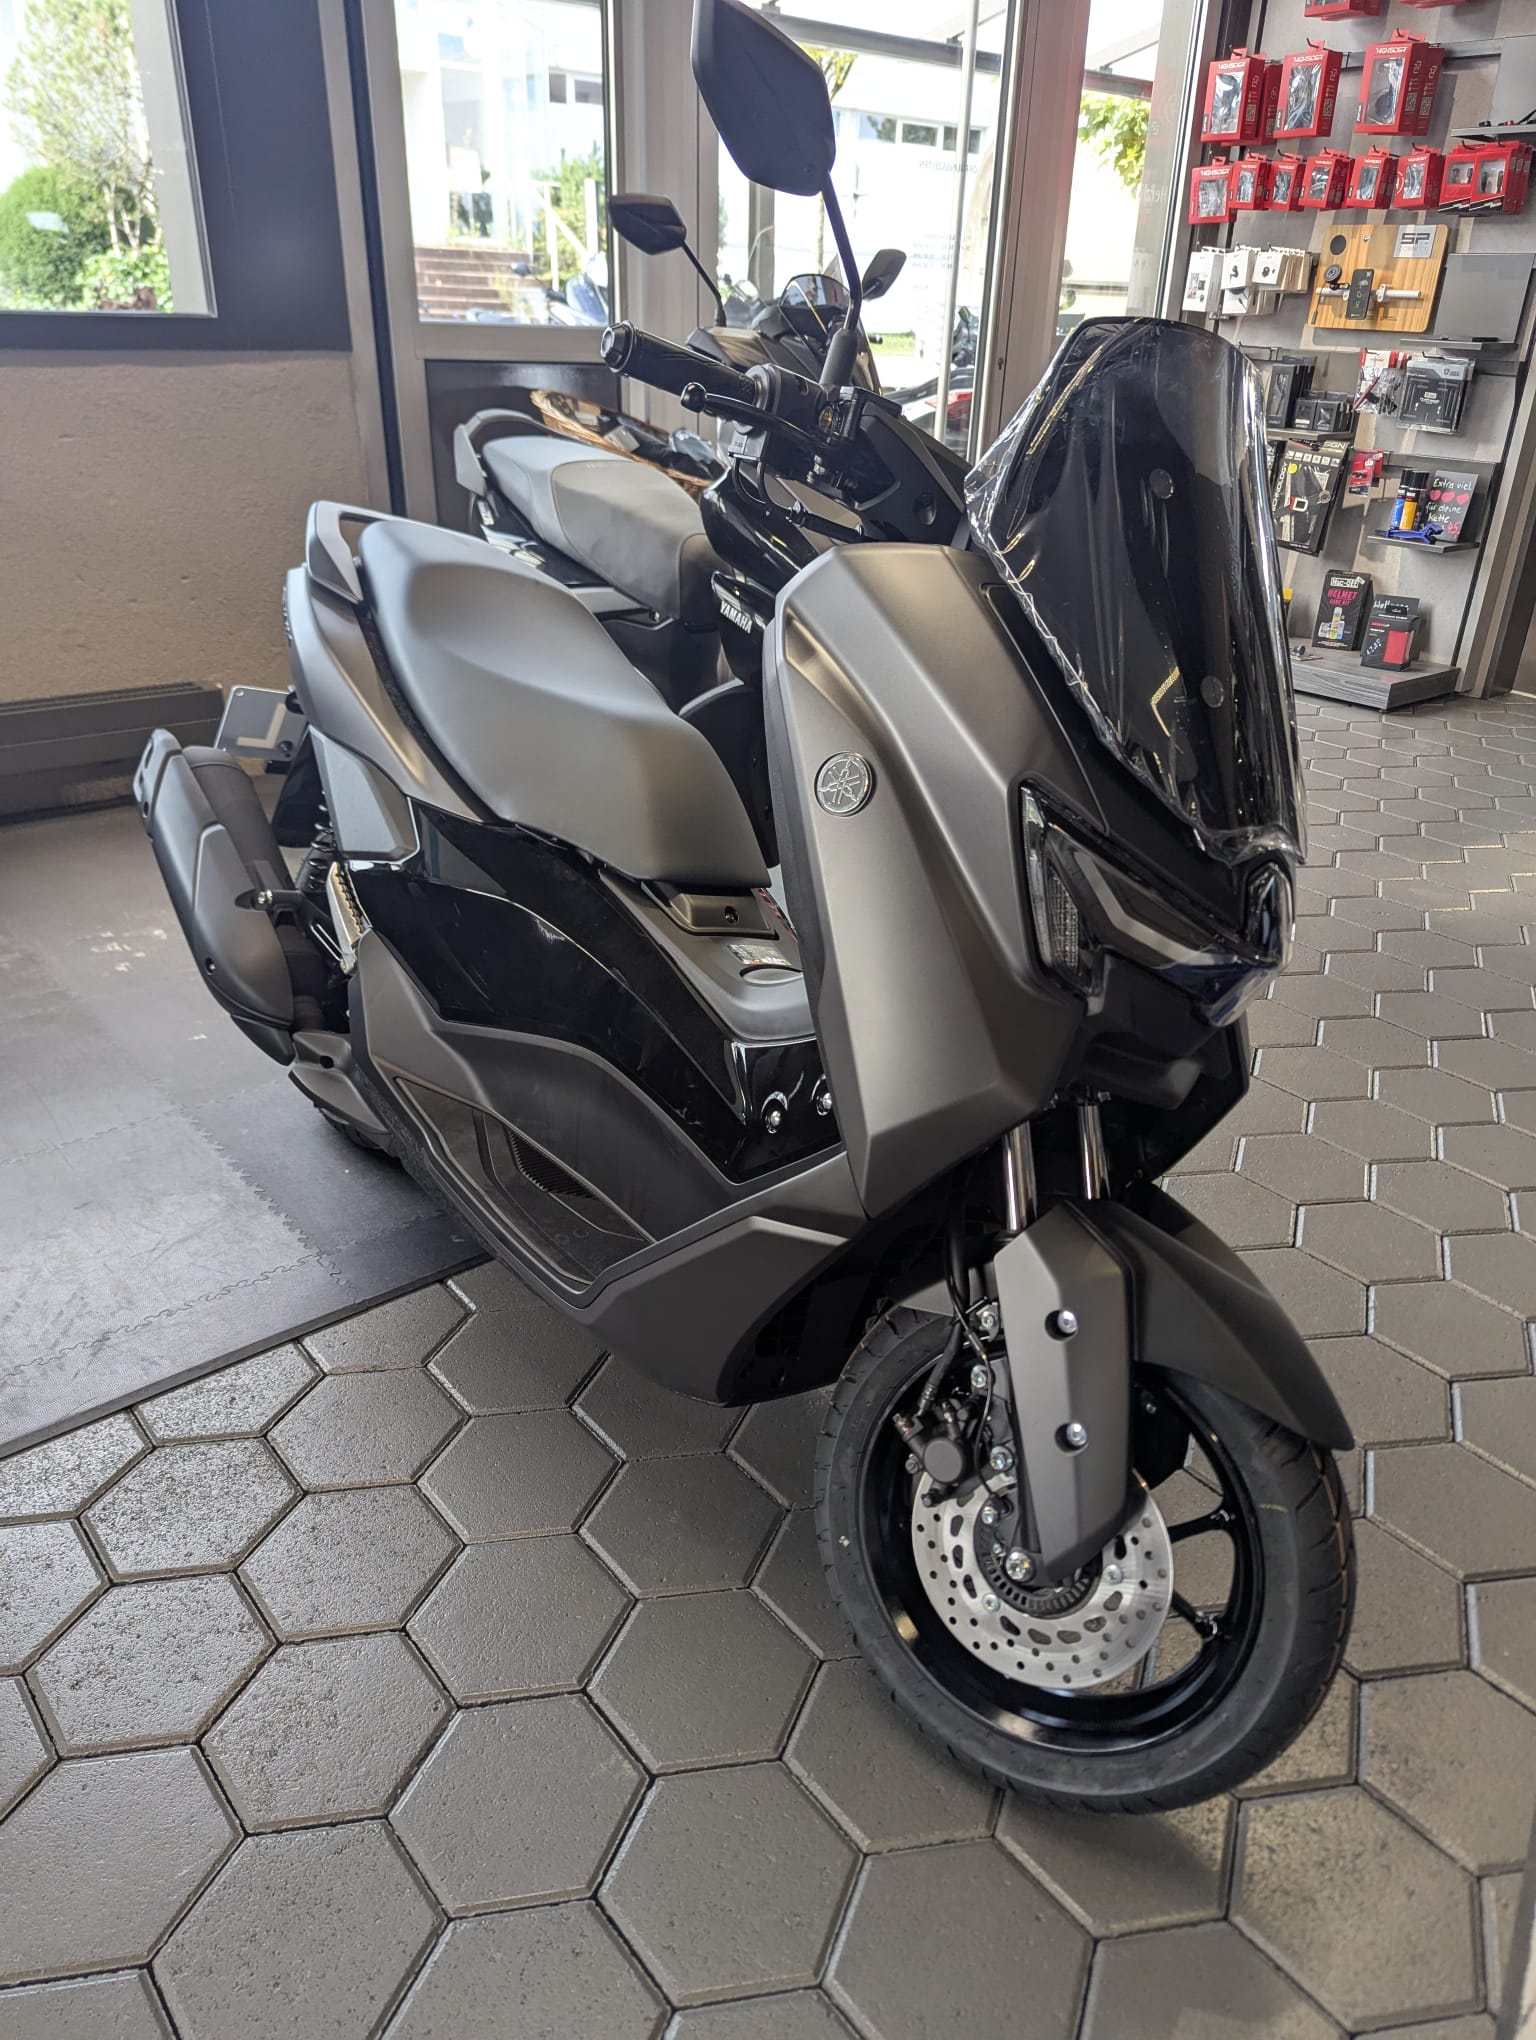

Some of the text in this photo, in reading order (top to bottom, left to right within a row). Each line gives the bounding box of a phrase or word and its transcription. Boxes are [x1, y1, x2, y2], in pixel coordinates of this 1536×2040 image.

[1400, 232, 1431, 245] SP
[1327, 588, 1358, 600] HELMET
[720, 600, 754, 635] YAMAHA
